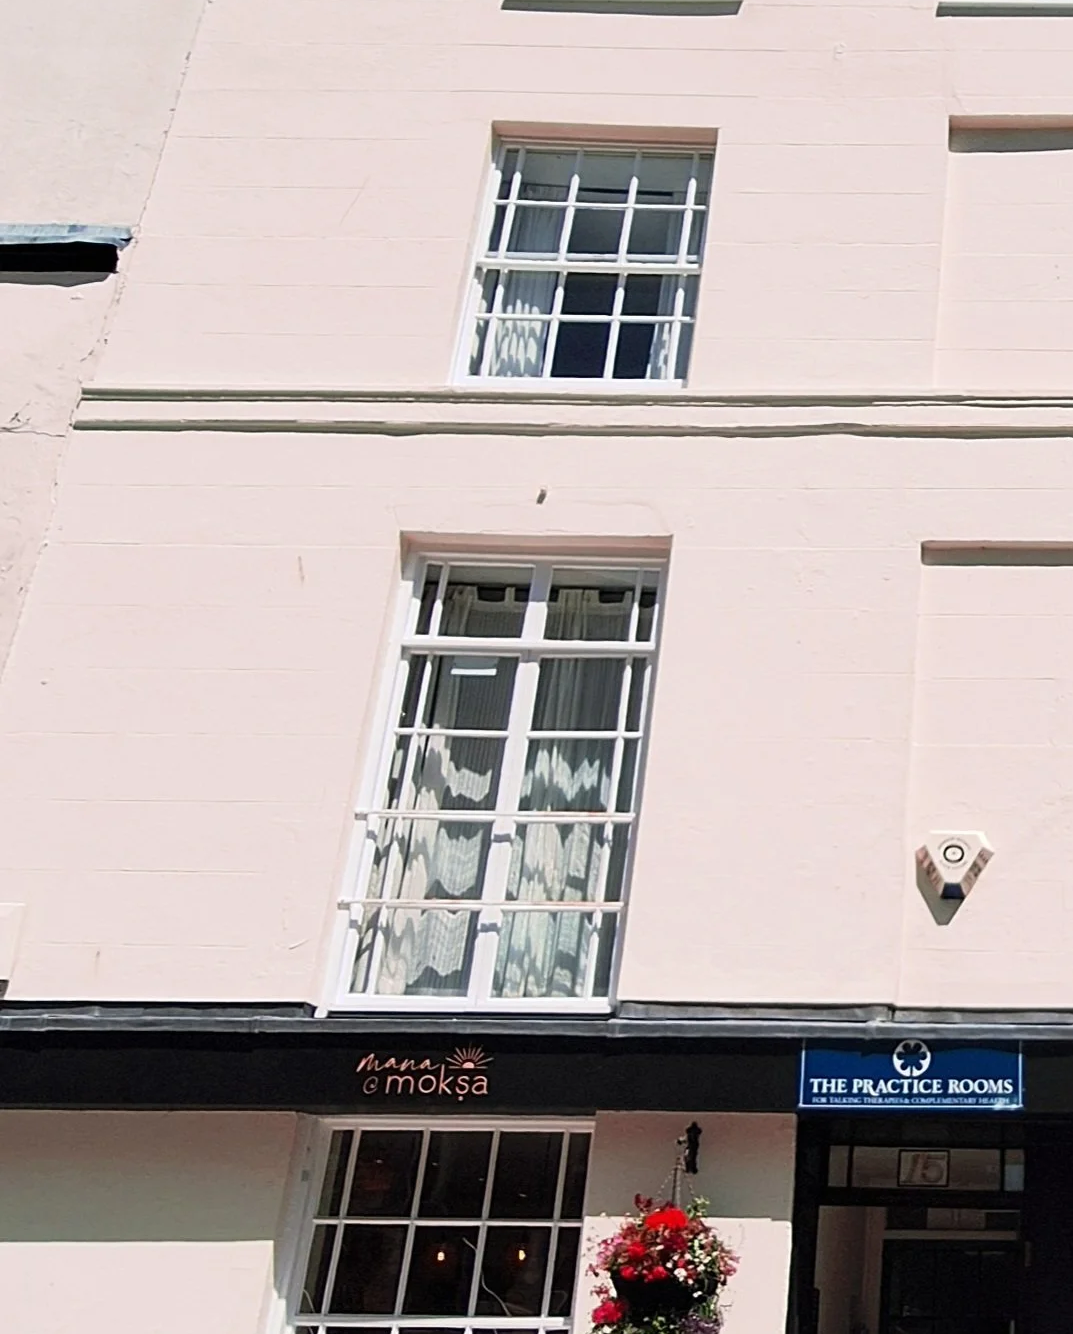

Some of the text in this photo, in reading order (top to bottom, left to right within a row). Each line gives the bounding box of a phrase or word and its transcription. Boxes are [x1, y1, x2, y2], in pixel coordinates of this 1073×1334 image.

[809, 1078, 1014, 1097] THE PRACTICE ROOMS
[812, 1096, 828, 1104] FOR
[829, 1096, 863, 1104] TALKING
[901, 1153, 946, 1184] 15
